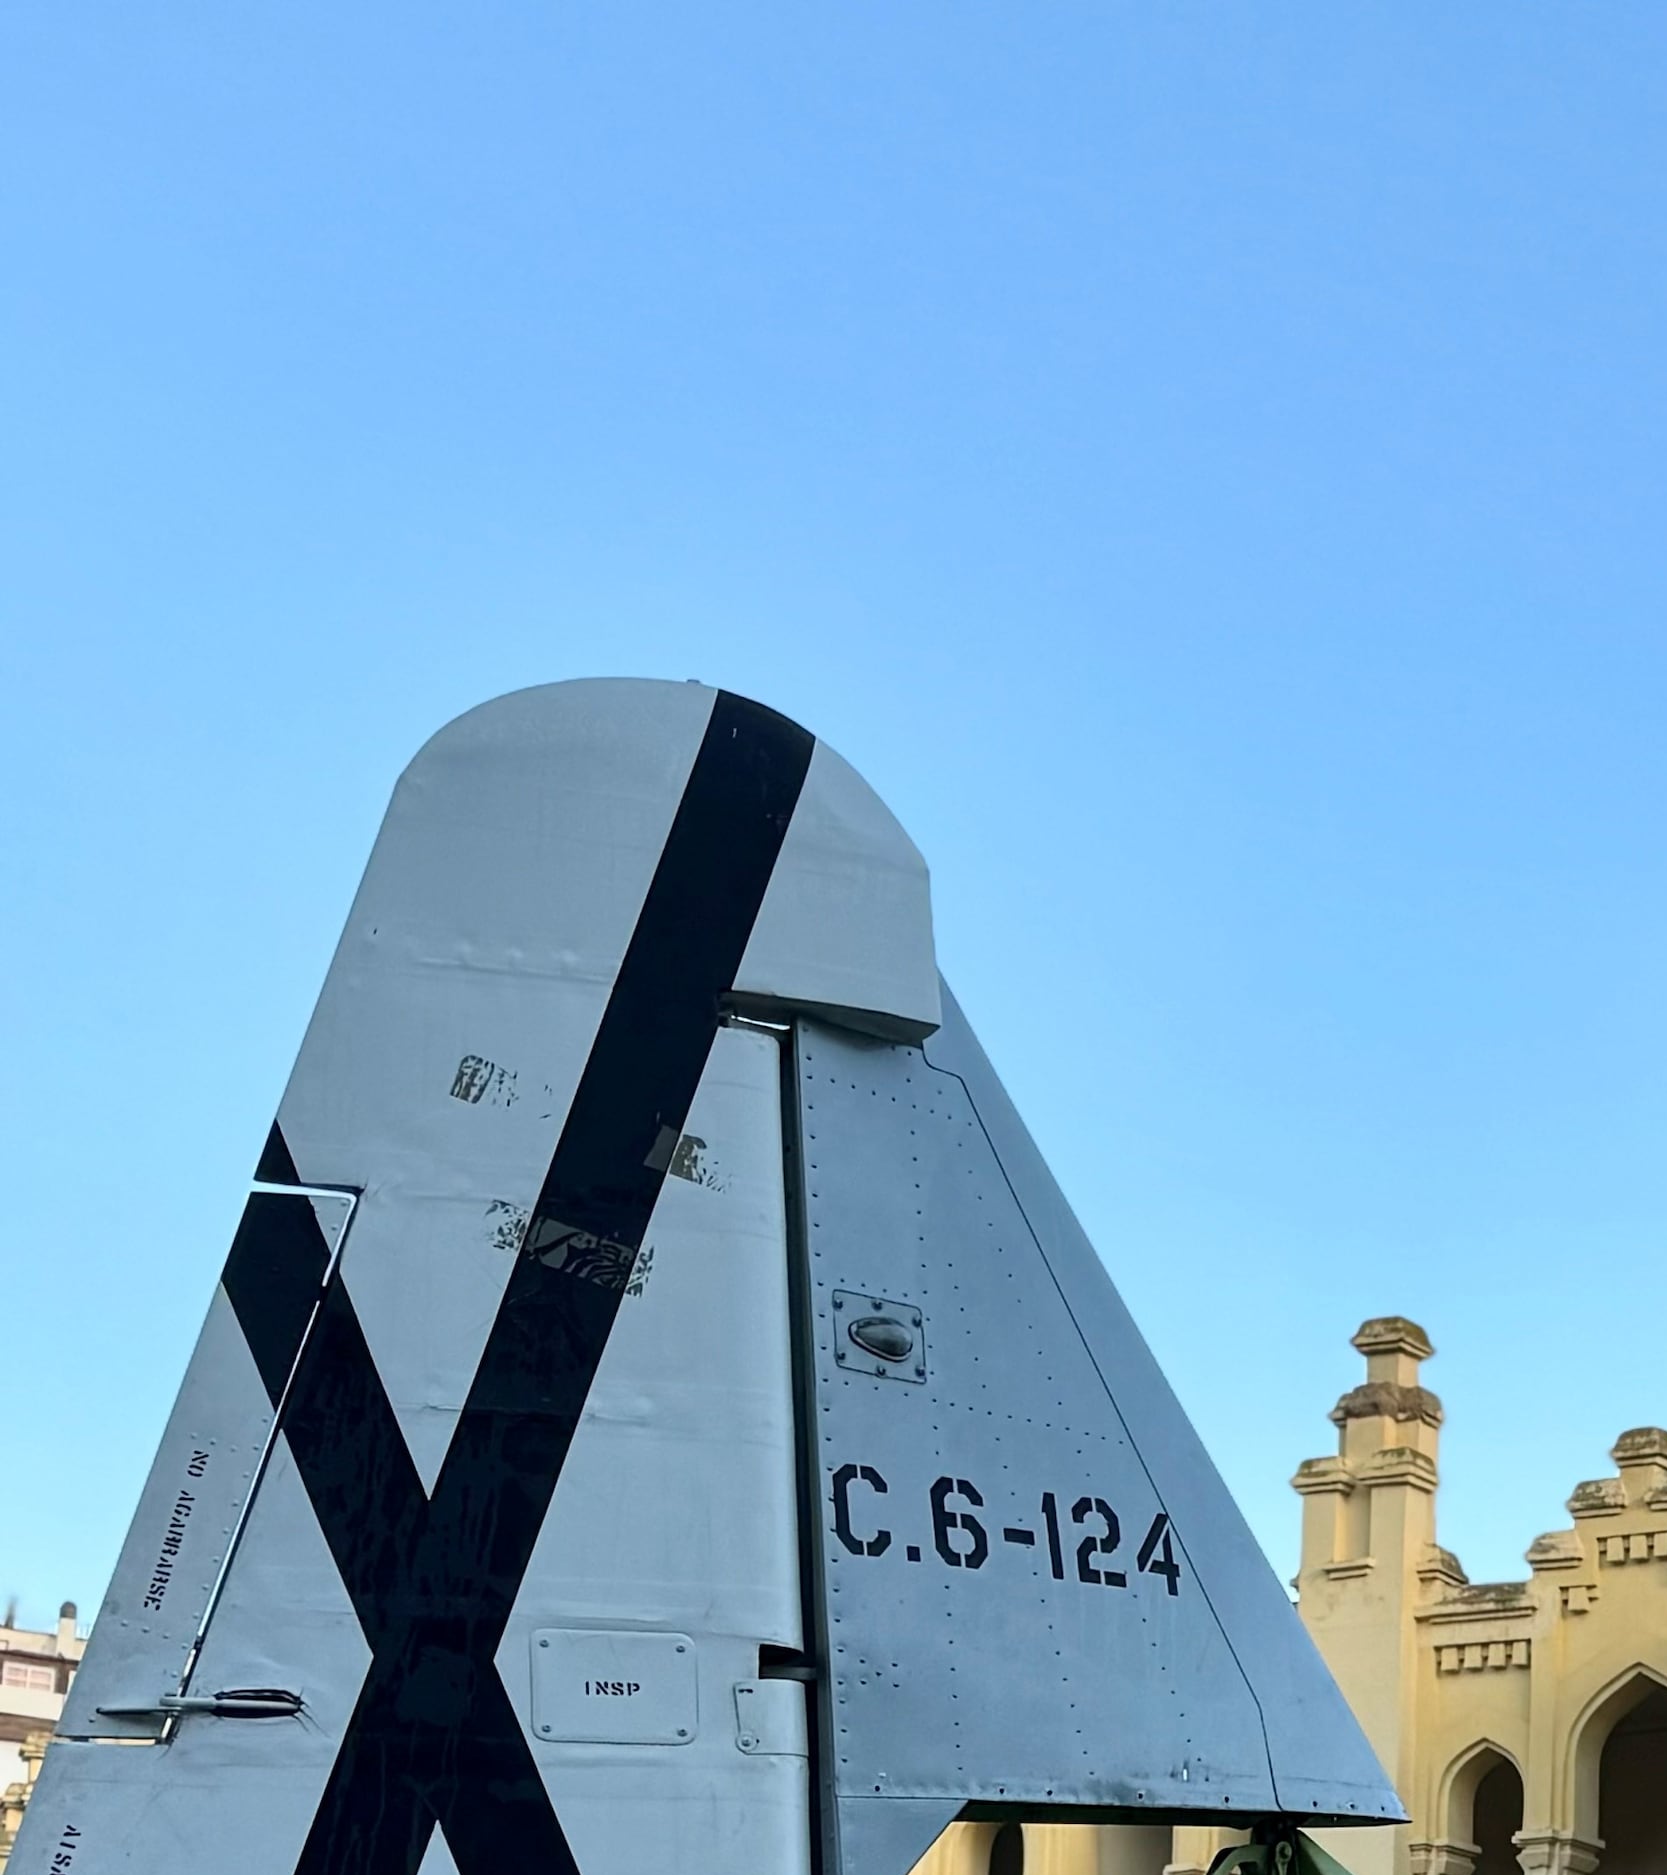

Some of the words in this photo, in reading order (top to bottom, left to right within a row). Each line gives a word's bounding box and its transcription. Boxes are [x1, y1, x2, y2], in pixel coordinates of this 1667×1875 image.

[186, 1449, 211, 1479] NO
[143, 1490, 196, 1612] AGARRARSE
[832, 1464, 1181, 1597] C.6-124
[585, 1681, 640, 1697] INSP
